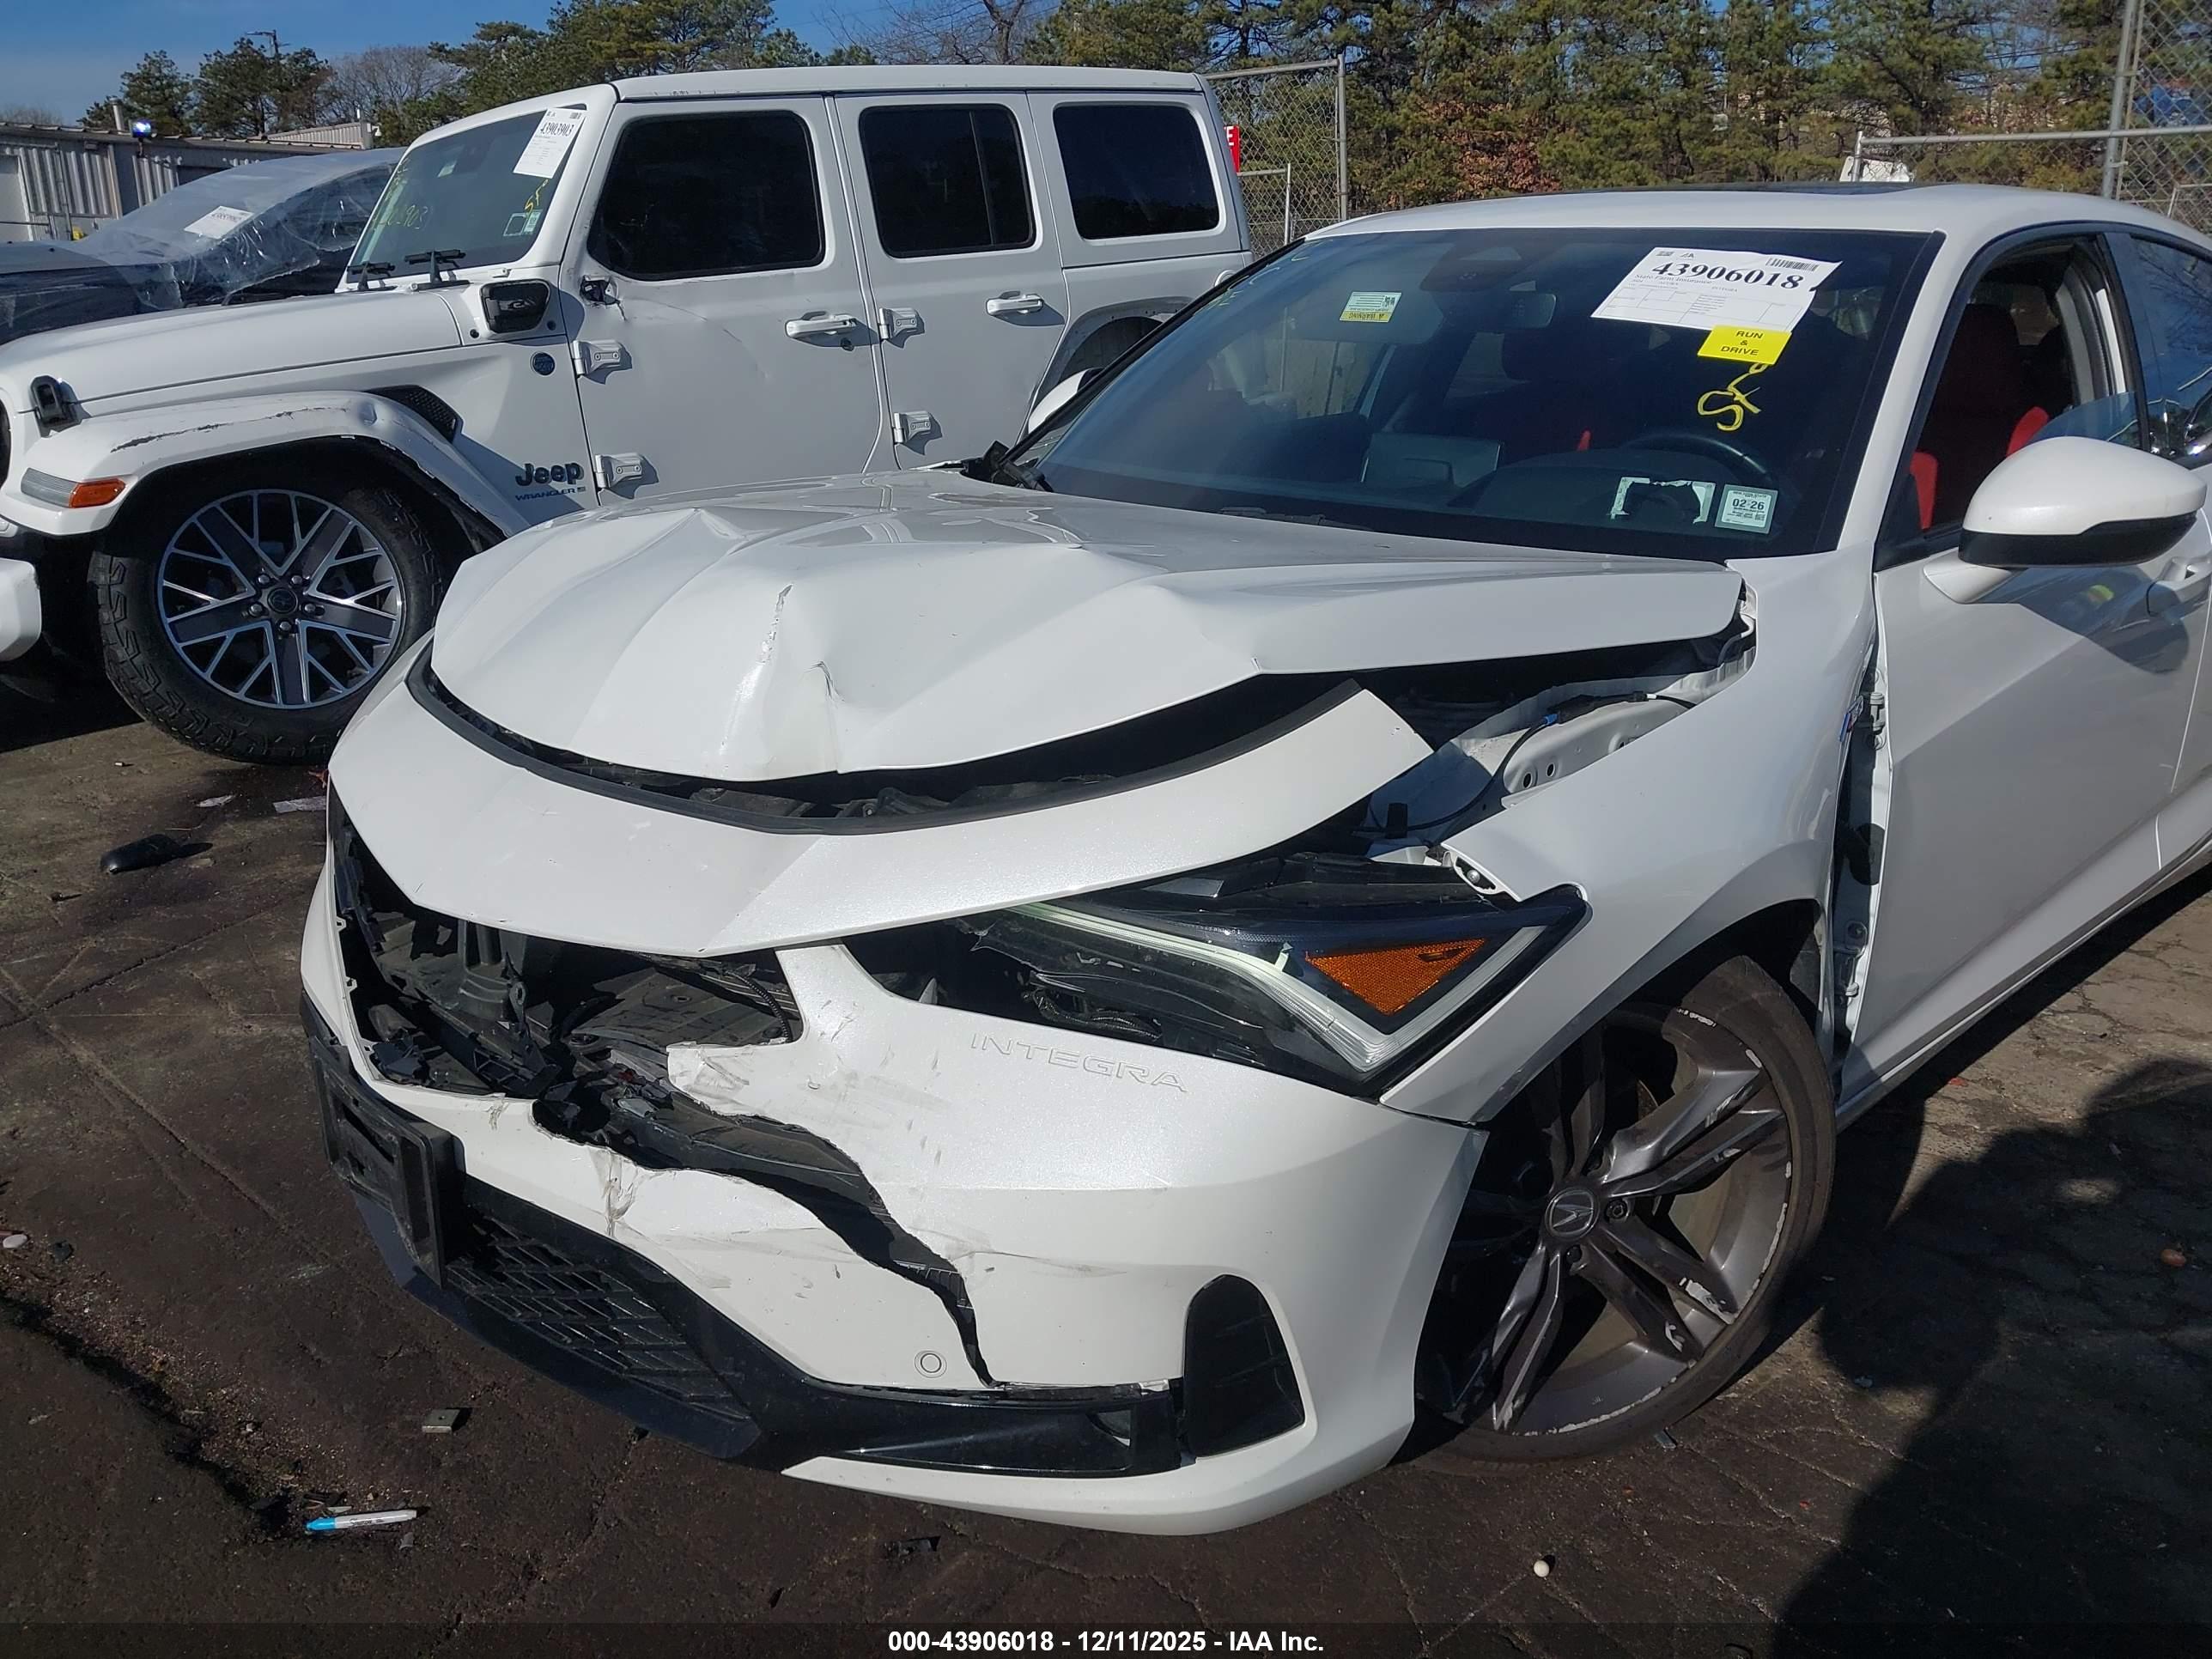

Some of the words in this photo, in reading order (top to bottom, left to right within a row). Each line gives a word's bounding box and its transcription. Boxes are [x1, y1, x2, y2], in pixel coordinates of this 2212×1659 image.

[1652, 262, 1804, 289] 43906018
[1736, 331, 1763, 339] RUN
[1721, 345, 1759, 356] DRIVE
[515, 463, 584, 486] Jeep
[515, 488, 576, 501] WRANGLER
[970, 1032, 1188, 1093] INTEGRA
